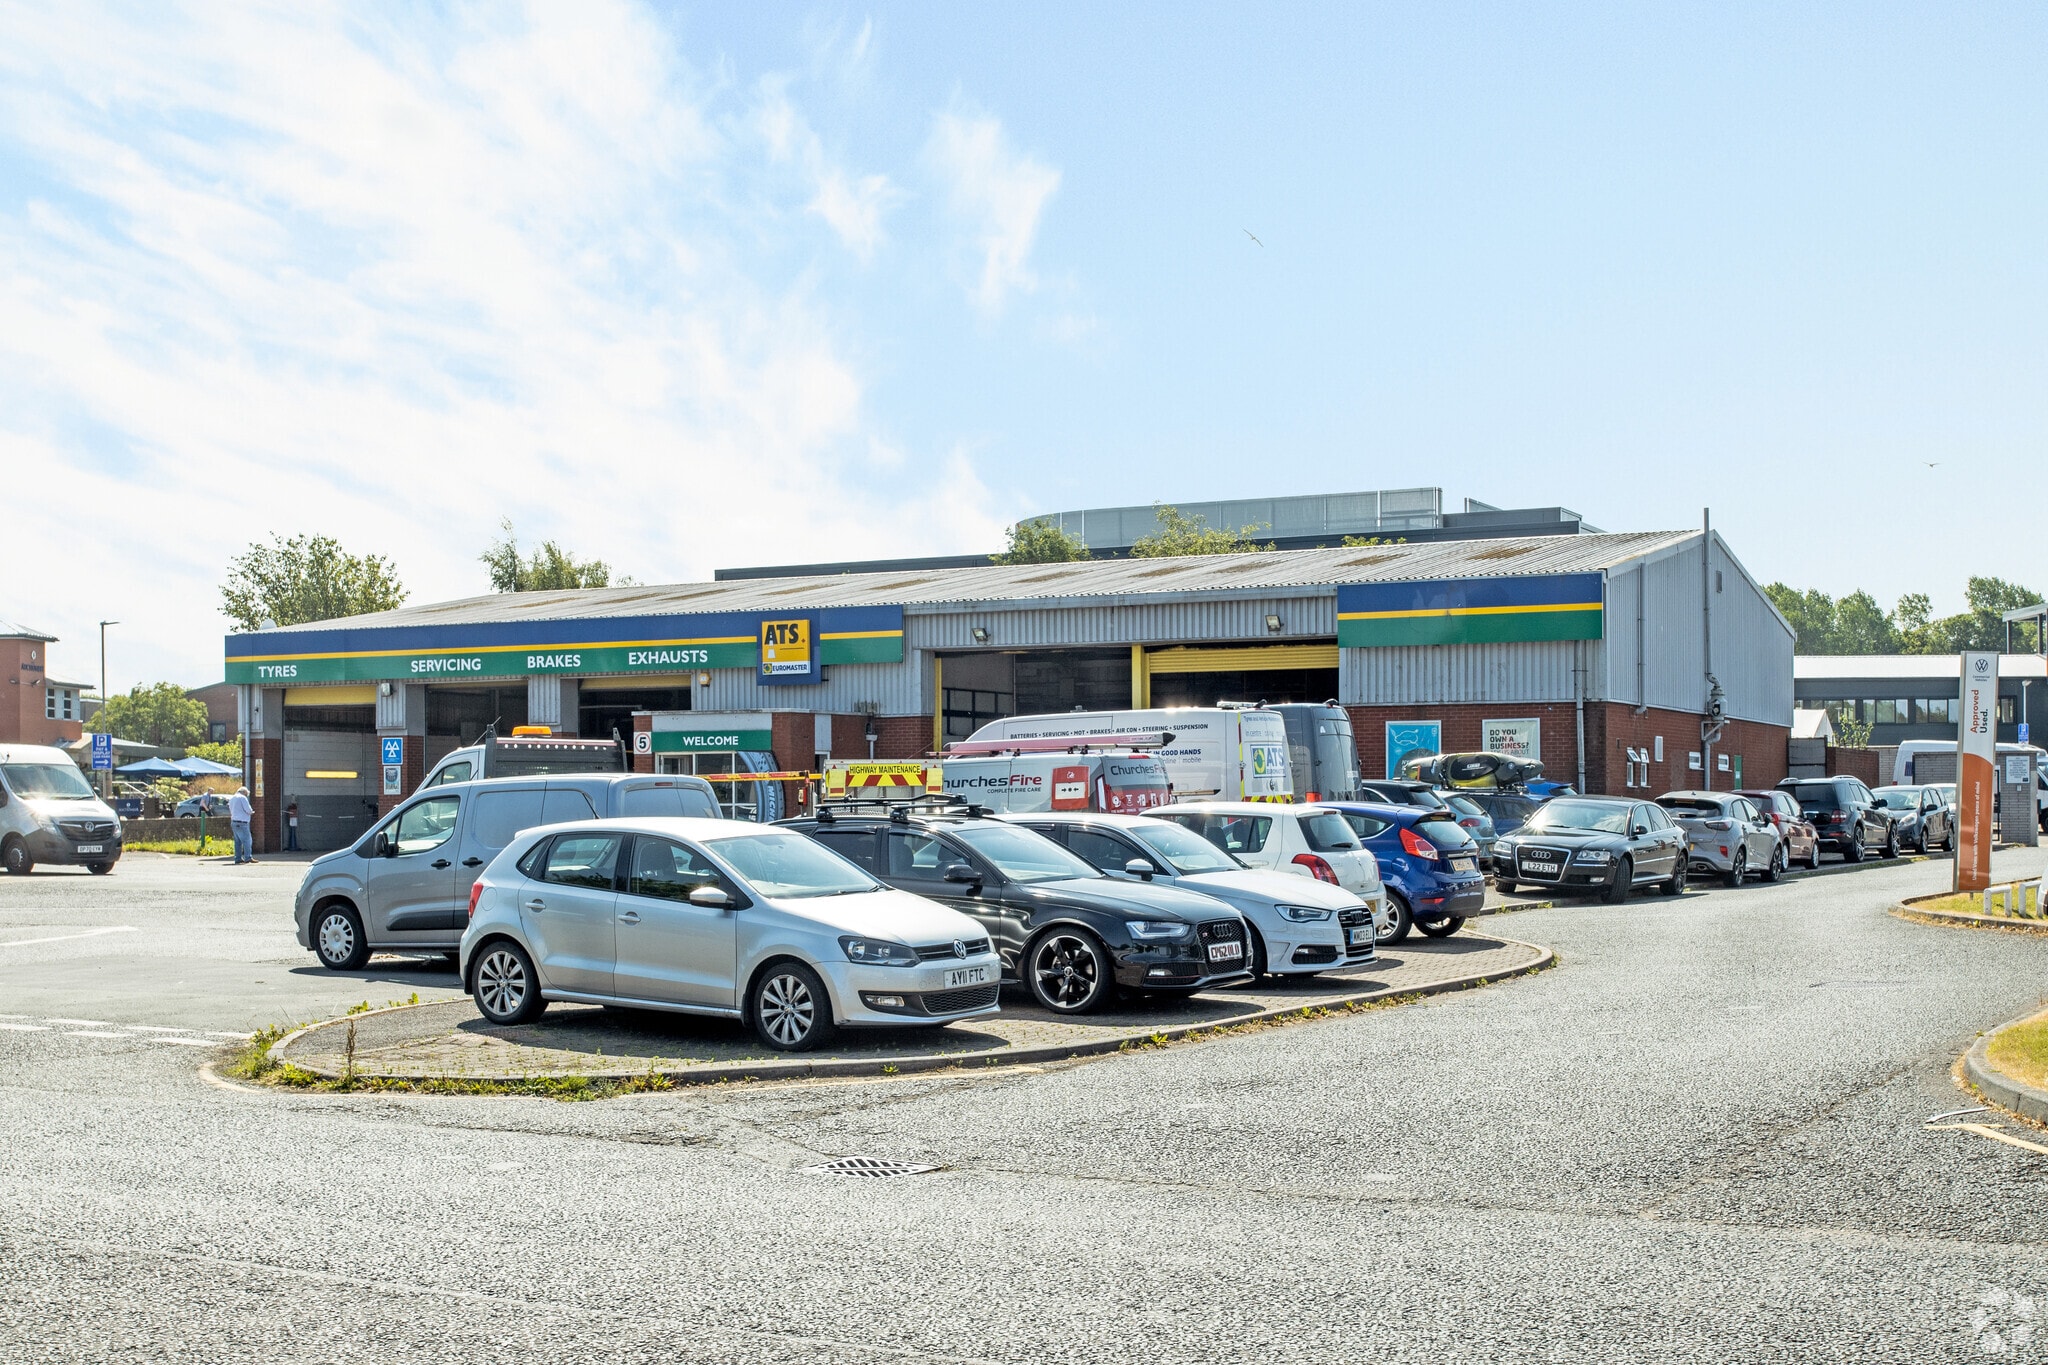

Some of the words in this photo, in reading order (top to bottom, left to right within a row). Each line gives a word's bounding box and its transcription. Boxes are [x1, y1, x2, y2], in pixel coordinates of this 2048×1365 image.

[765, 623, 799, 645] ATS
[258, 665, 297, 678] TYRES
[411, 658, 482, 673] SERVICING
[527, 654, 581, 668] BRAKES
[628, 650, 708, 665] EXHAUSTS
[772, 664, 808, 672] EUROMASTER
[1970, 689, 1979, 733] Approved
[1980, 709, 1988, 733] Used.
[98, 736, 106, 745] P
[639, 736, 647, 749] 5
[683, 736, 739, 746] WELCOME
[1266, 747, 1285, 766] ATS
[849, 766, 878, 774] HIGHWAY
[878, 765, 921, 774] MAINTENANCE
[942, 774, 1042, 788] hurchesFire
[767, 785, 777, 821] MICH
[951, 970, 968, 985] AY11
[969, 968, 984, 982] FTC
